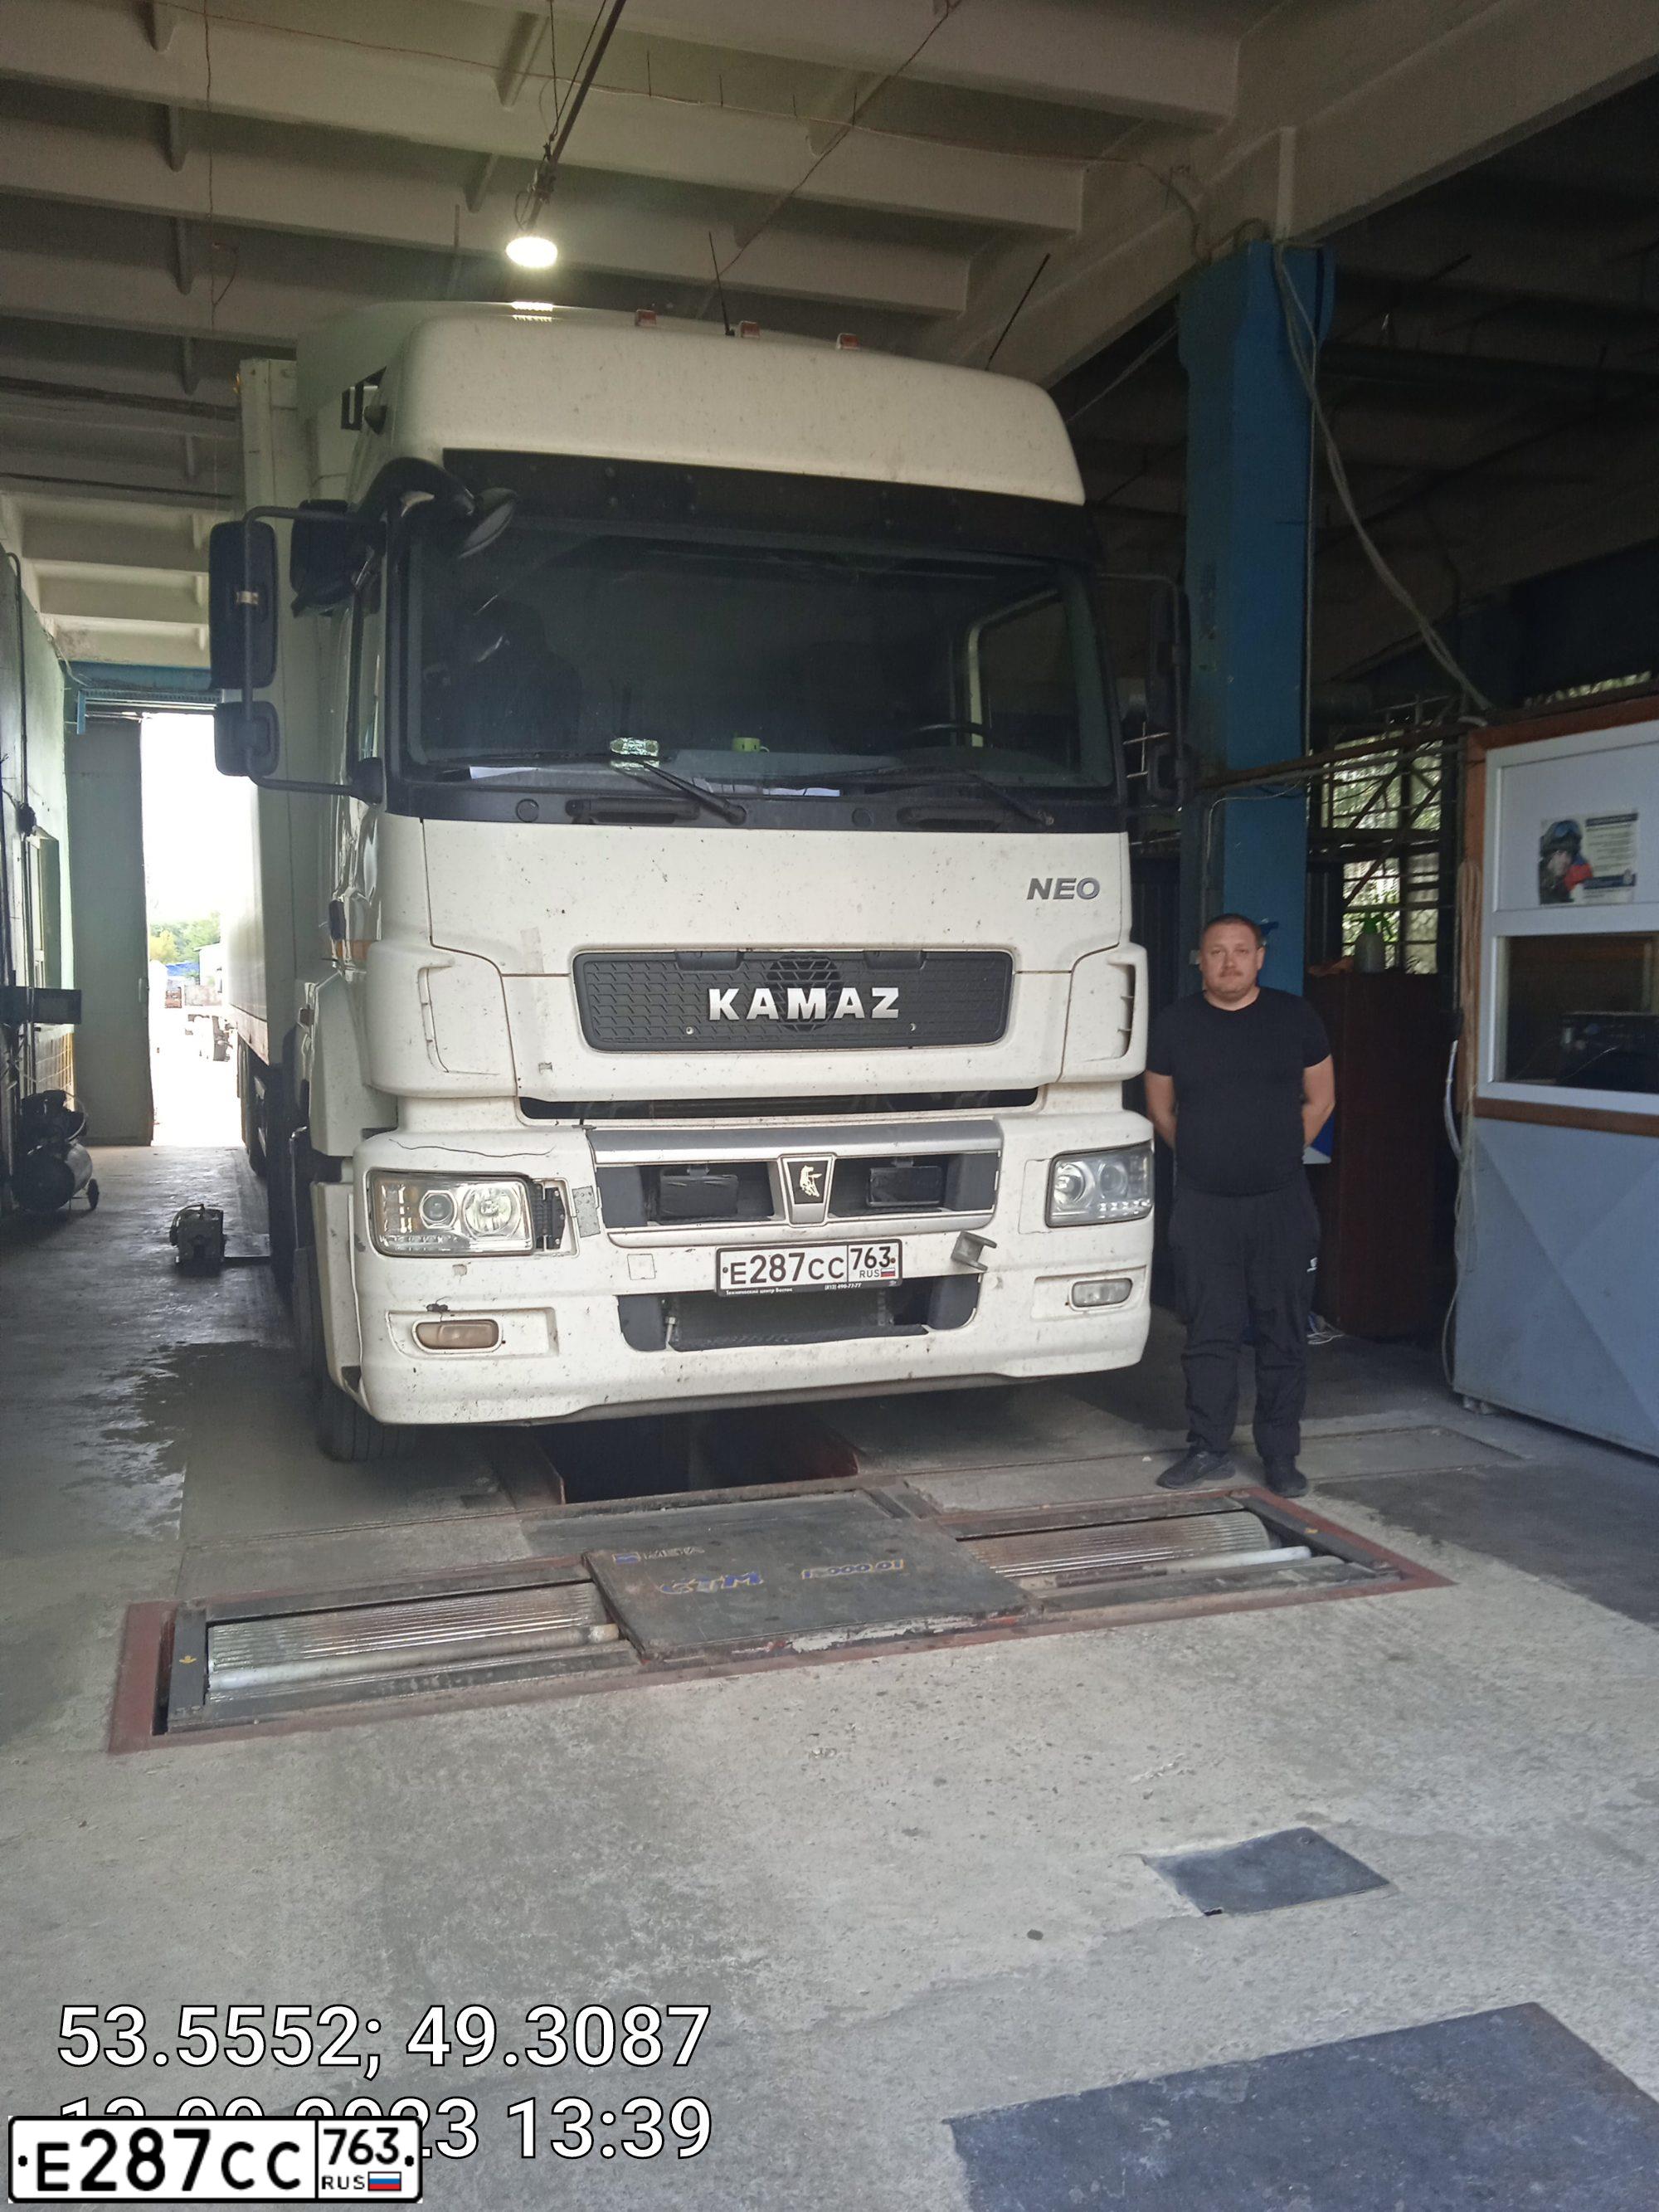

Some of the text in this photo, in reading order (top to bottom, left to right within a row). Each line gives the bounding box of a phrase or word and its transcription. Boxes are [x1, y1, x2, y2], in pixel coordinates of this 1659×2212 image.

[1026, 877, 1101, 900] NEO
[708, 987, 900, 1021] KAMAZ
[730, 1246, 891, 1285] E287CC 763
[859, 1269, 879, 1278] RUS
